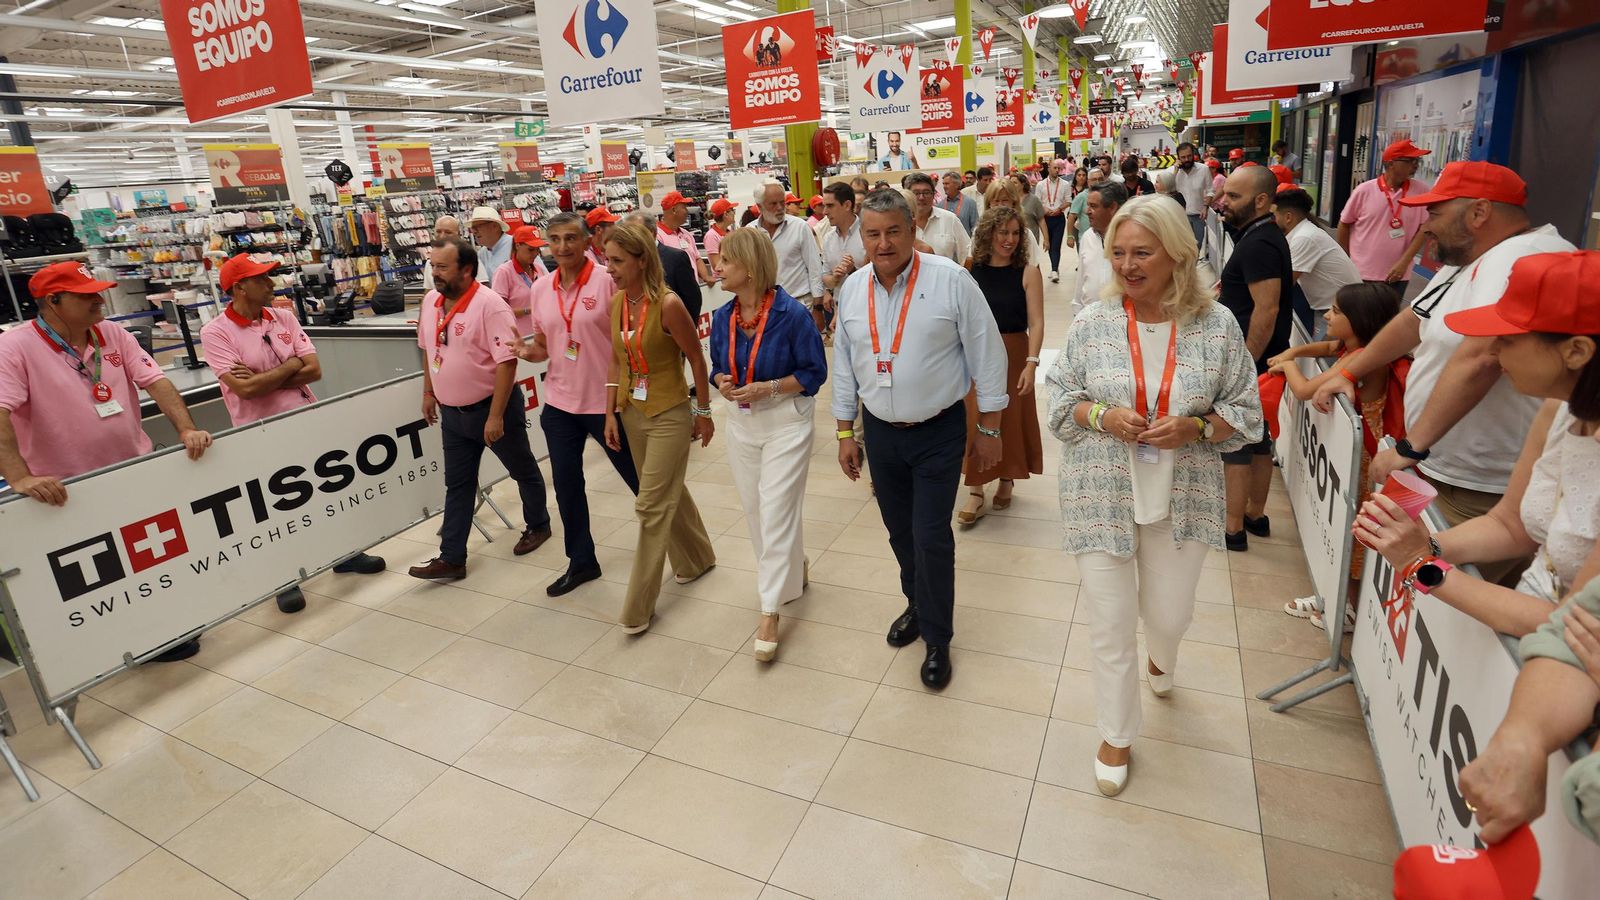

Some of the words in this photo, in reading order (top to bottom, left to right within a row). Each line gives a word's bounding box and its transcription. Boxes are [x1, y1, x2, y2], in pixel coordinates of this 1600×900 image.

[1320, 22, 1425, 38] #CARREFOURCONLAVUELTA
[193, 20, 273, 72] EQUIPO
[560, 66, 642, 94] Carrefour
[744, 73, 800, 93] SOMOS
[744, 88, 802, 108] EQUIPO
[921, 101, 953, 112] OMOS
[859, 103, 911, 117] Carrefour
[921, 110, 953, 121] QUIPO
[964, 115, 989, 124] refour
[606, 153, 624, 162] Super
[243, 172, 281, 181] REBAJAS
[408, 166, 432, 174] EBAJAS
[190, 418, 431, 539] TISSOT
[68, 574, 173, 628] SWISS
[190, 514, 312, 575] WATCHES
[325, 481, 389, 518] SINCE
[398, 460, 440, 486] 1853
[1367, 599, 1393, 680] SWISS
[1413, 608, 1488, 849] TIS
